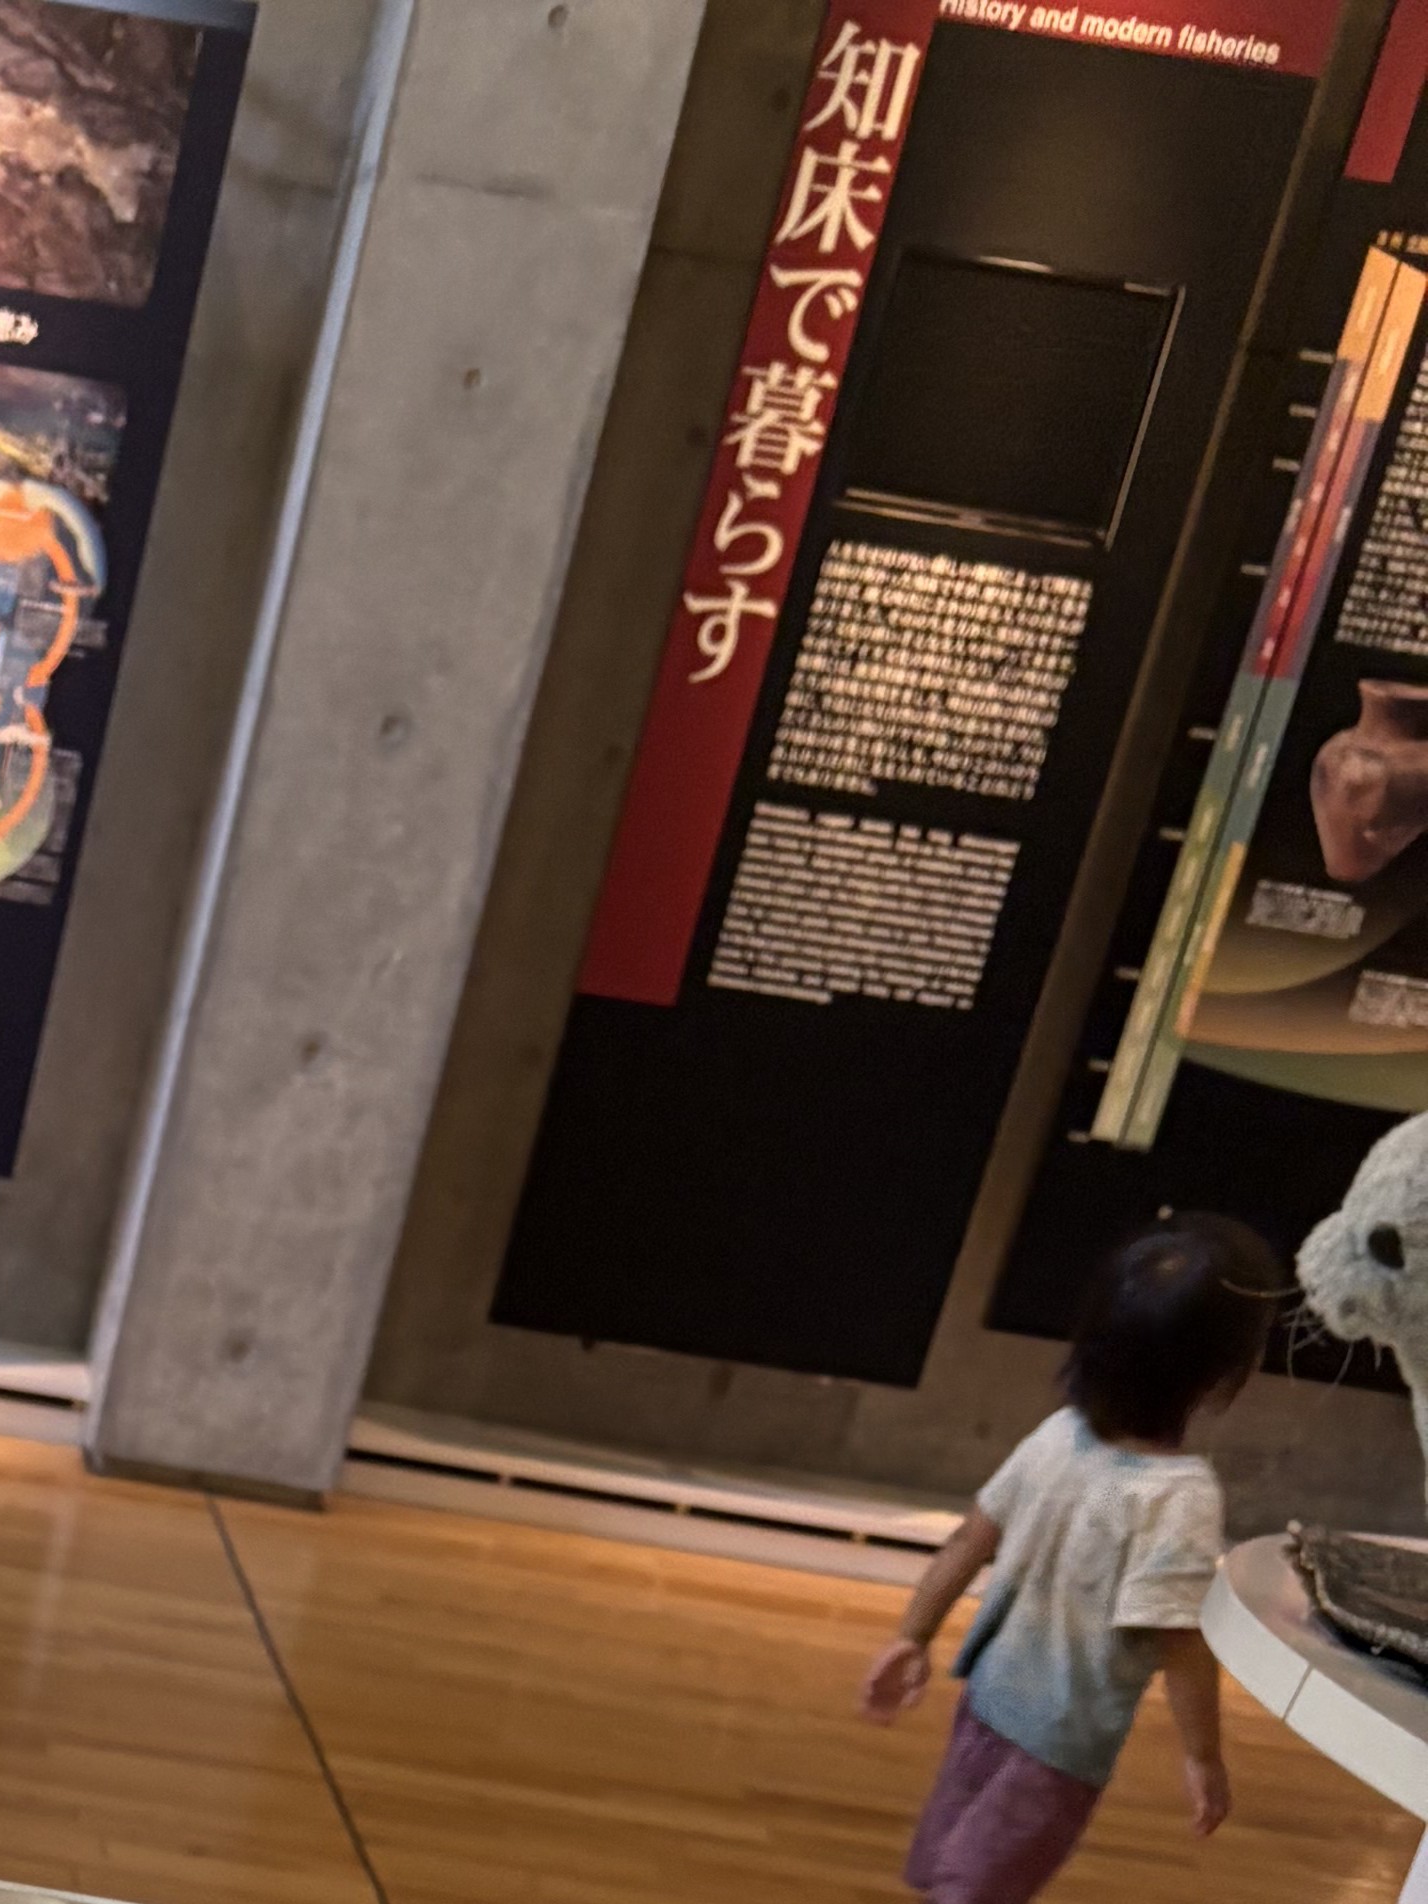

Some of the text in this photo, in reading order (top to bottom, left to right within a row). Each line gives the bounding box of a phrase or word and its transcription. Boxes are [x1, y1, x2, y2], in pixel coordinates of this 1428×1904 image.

[1030, 8, 1076, 34] and
[1081, 17, 1172, 48] modern
[1178, 24, 1281, 66] fisheries
[684, 20, 920, 684] 知床で暮らす
